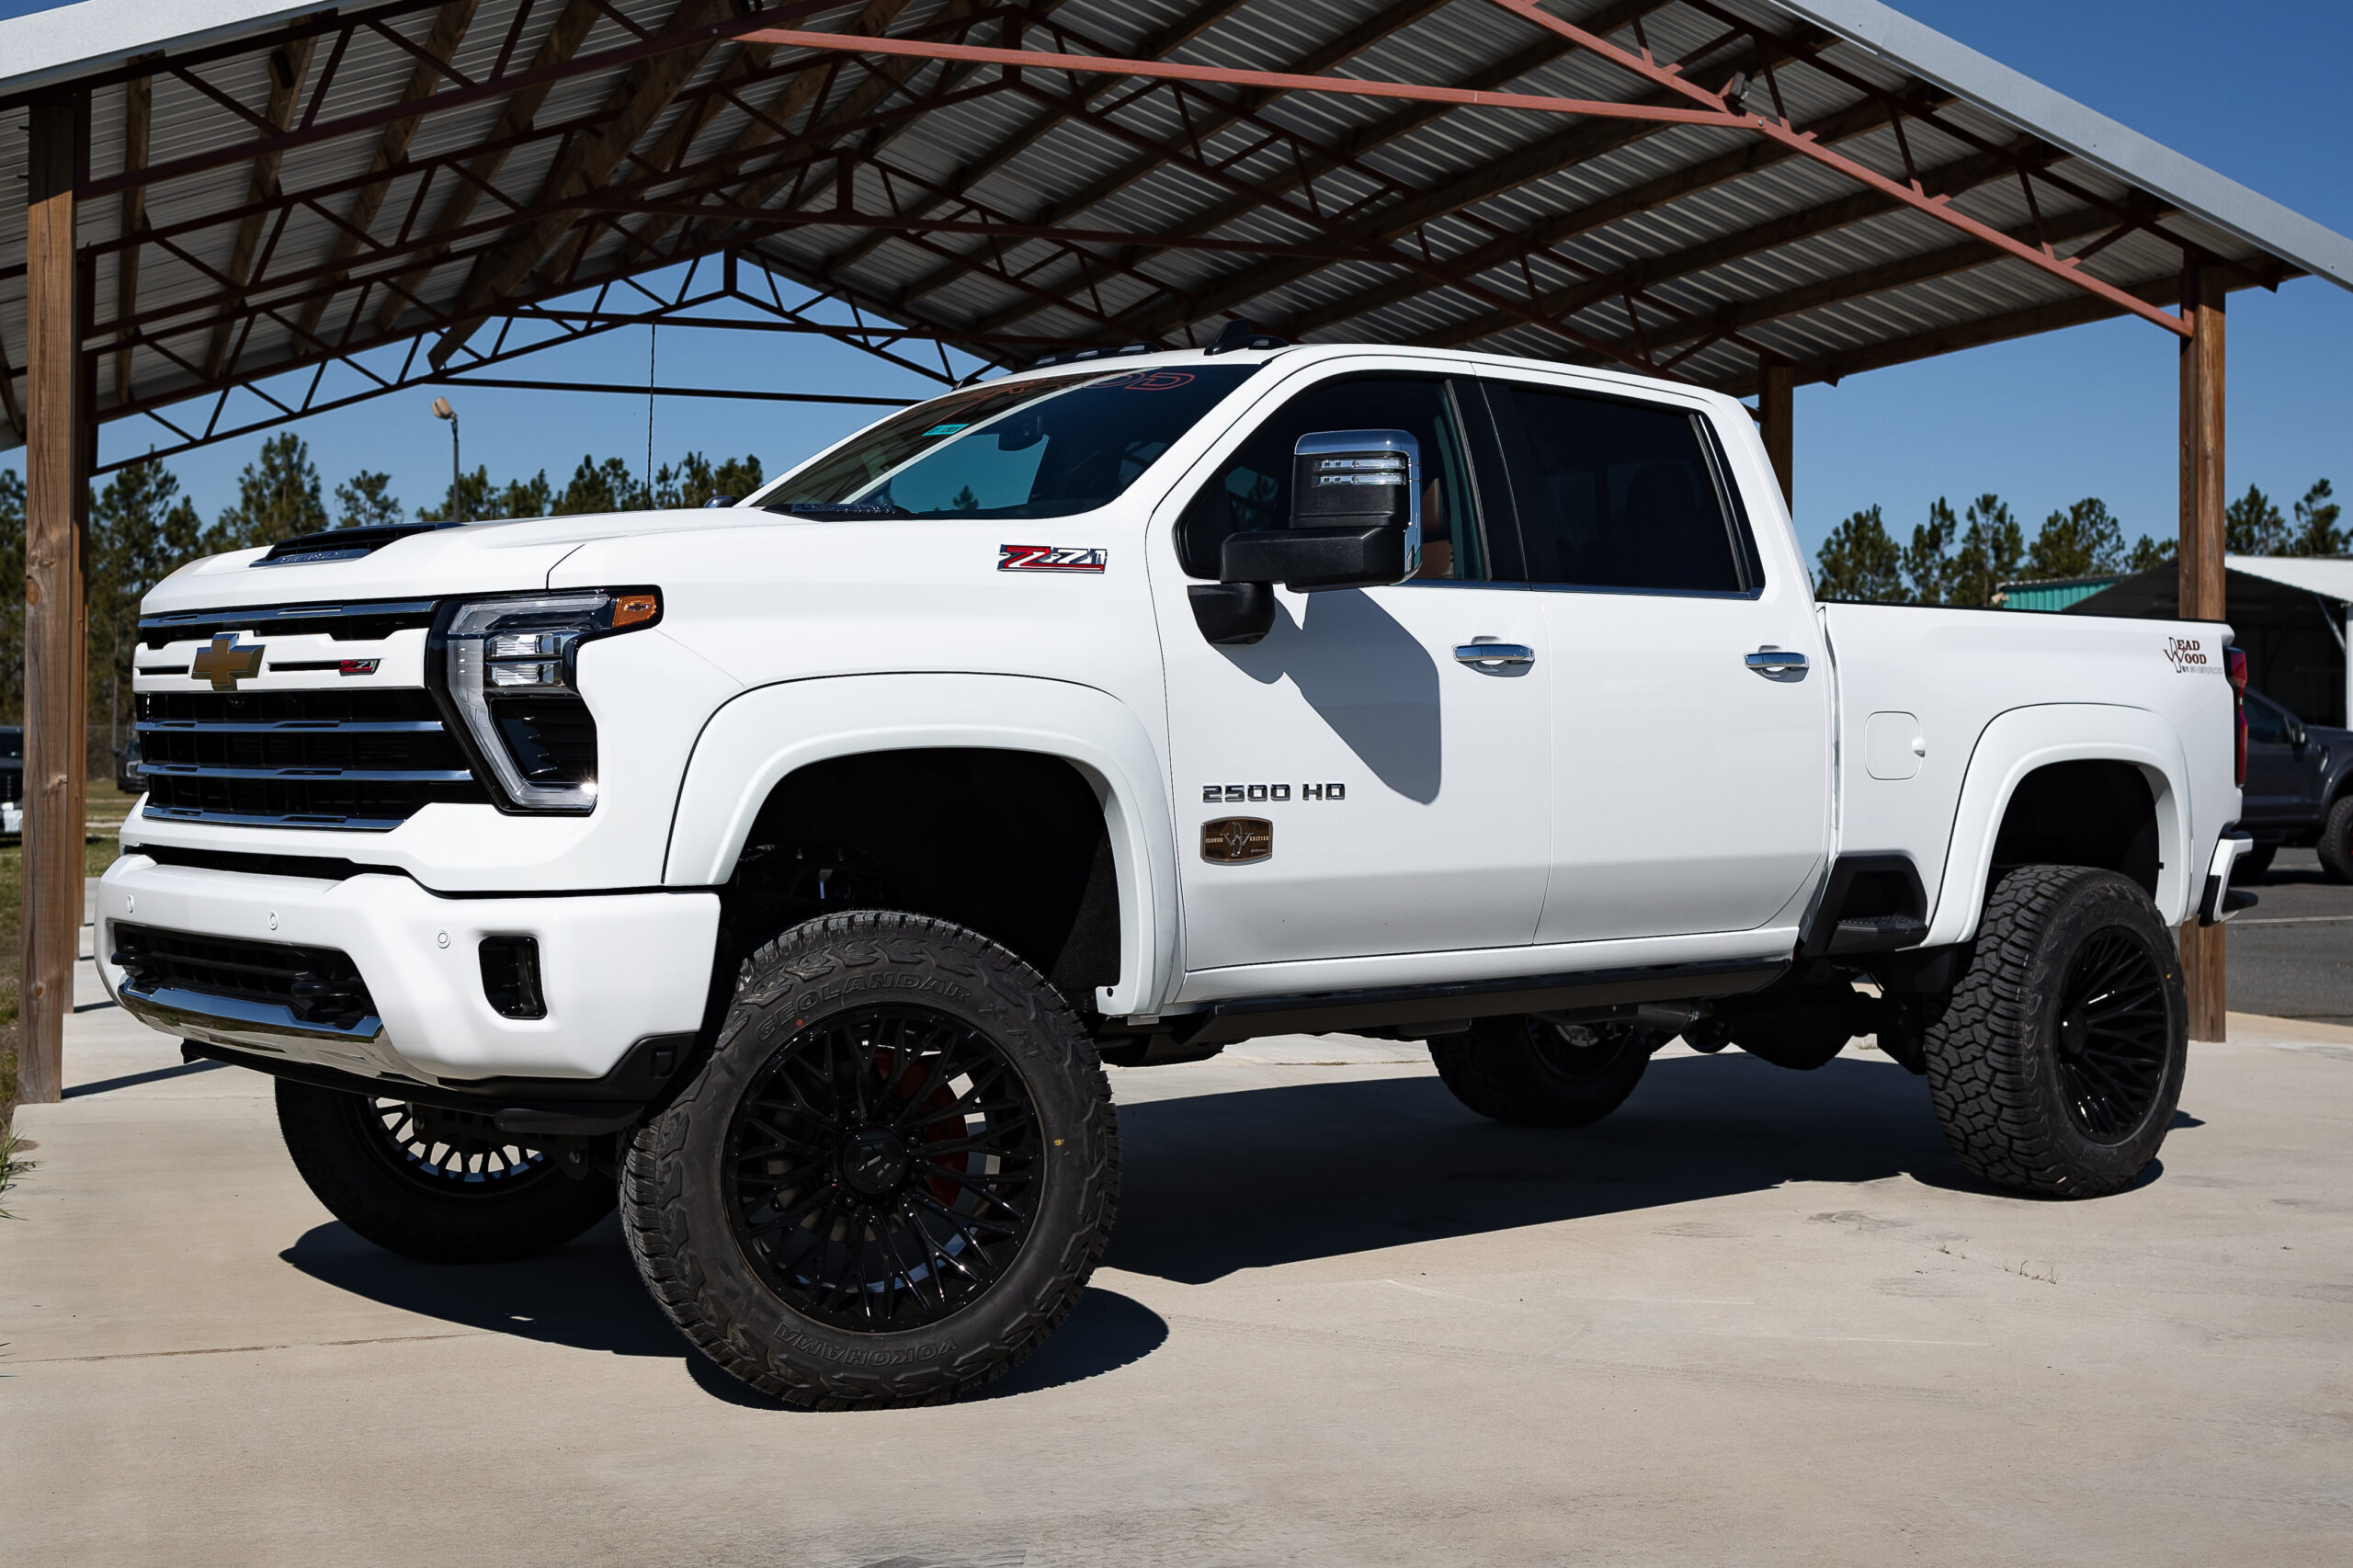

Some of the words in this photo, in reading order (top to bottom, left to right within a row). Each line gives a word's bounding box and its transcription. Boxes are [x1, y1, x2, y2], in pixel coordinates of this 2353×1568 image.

[997, 544, 1108, 574] Z71
[1202, 783, 1291, 803] 2500
[1302, 783, 1346, 801] HD
[756, 972, 973, 1041] GEOLANDAR
[774, 1323, 961, 1367] YOKOHAMA
